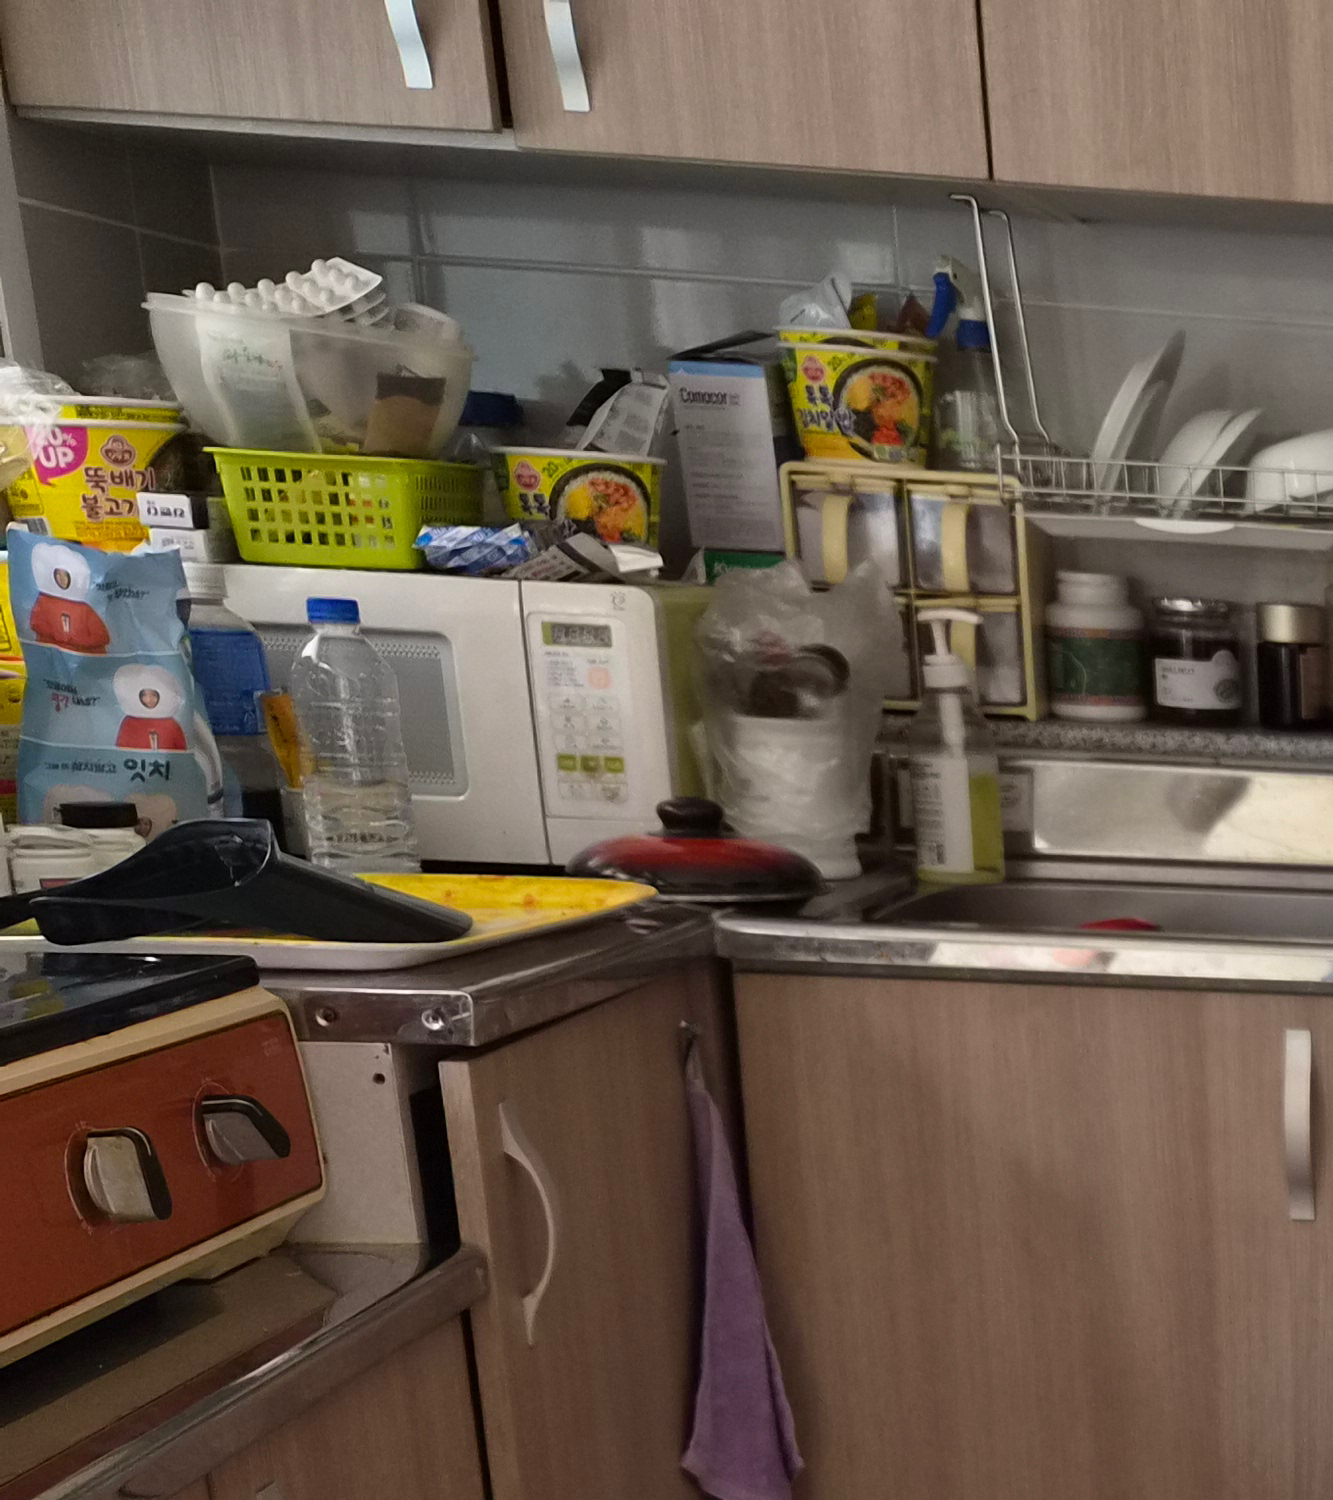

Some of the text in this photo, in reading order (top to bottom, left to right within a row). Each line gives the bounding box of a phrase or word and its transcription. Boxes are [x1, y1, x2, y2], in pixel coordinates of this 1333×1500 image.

[39, 446, 75, 469] UP
[83, 466, 156, 494] 뚝배기
[123, 757, 170, 782] 잇치
